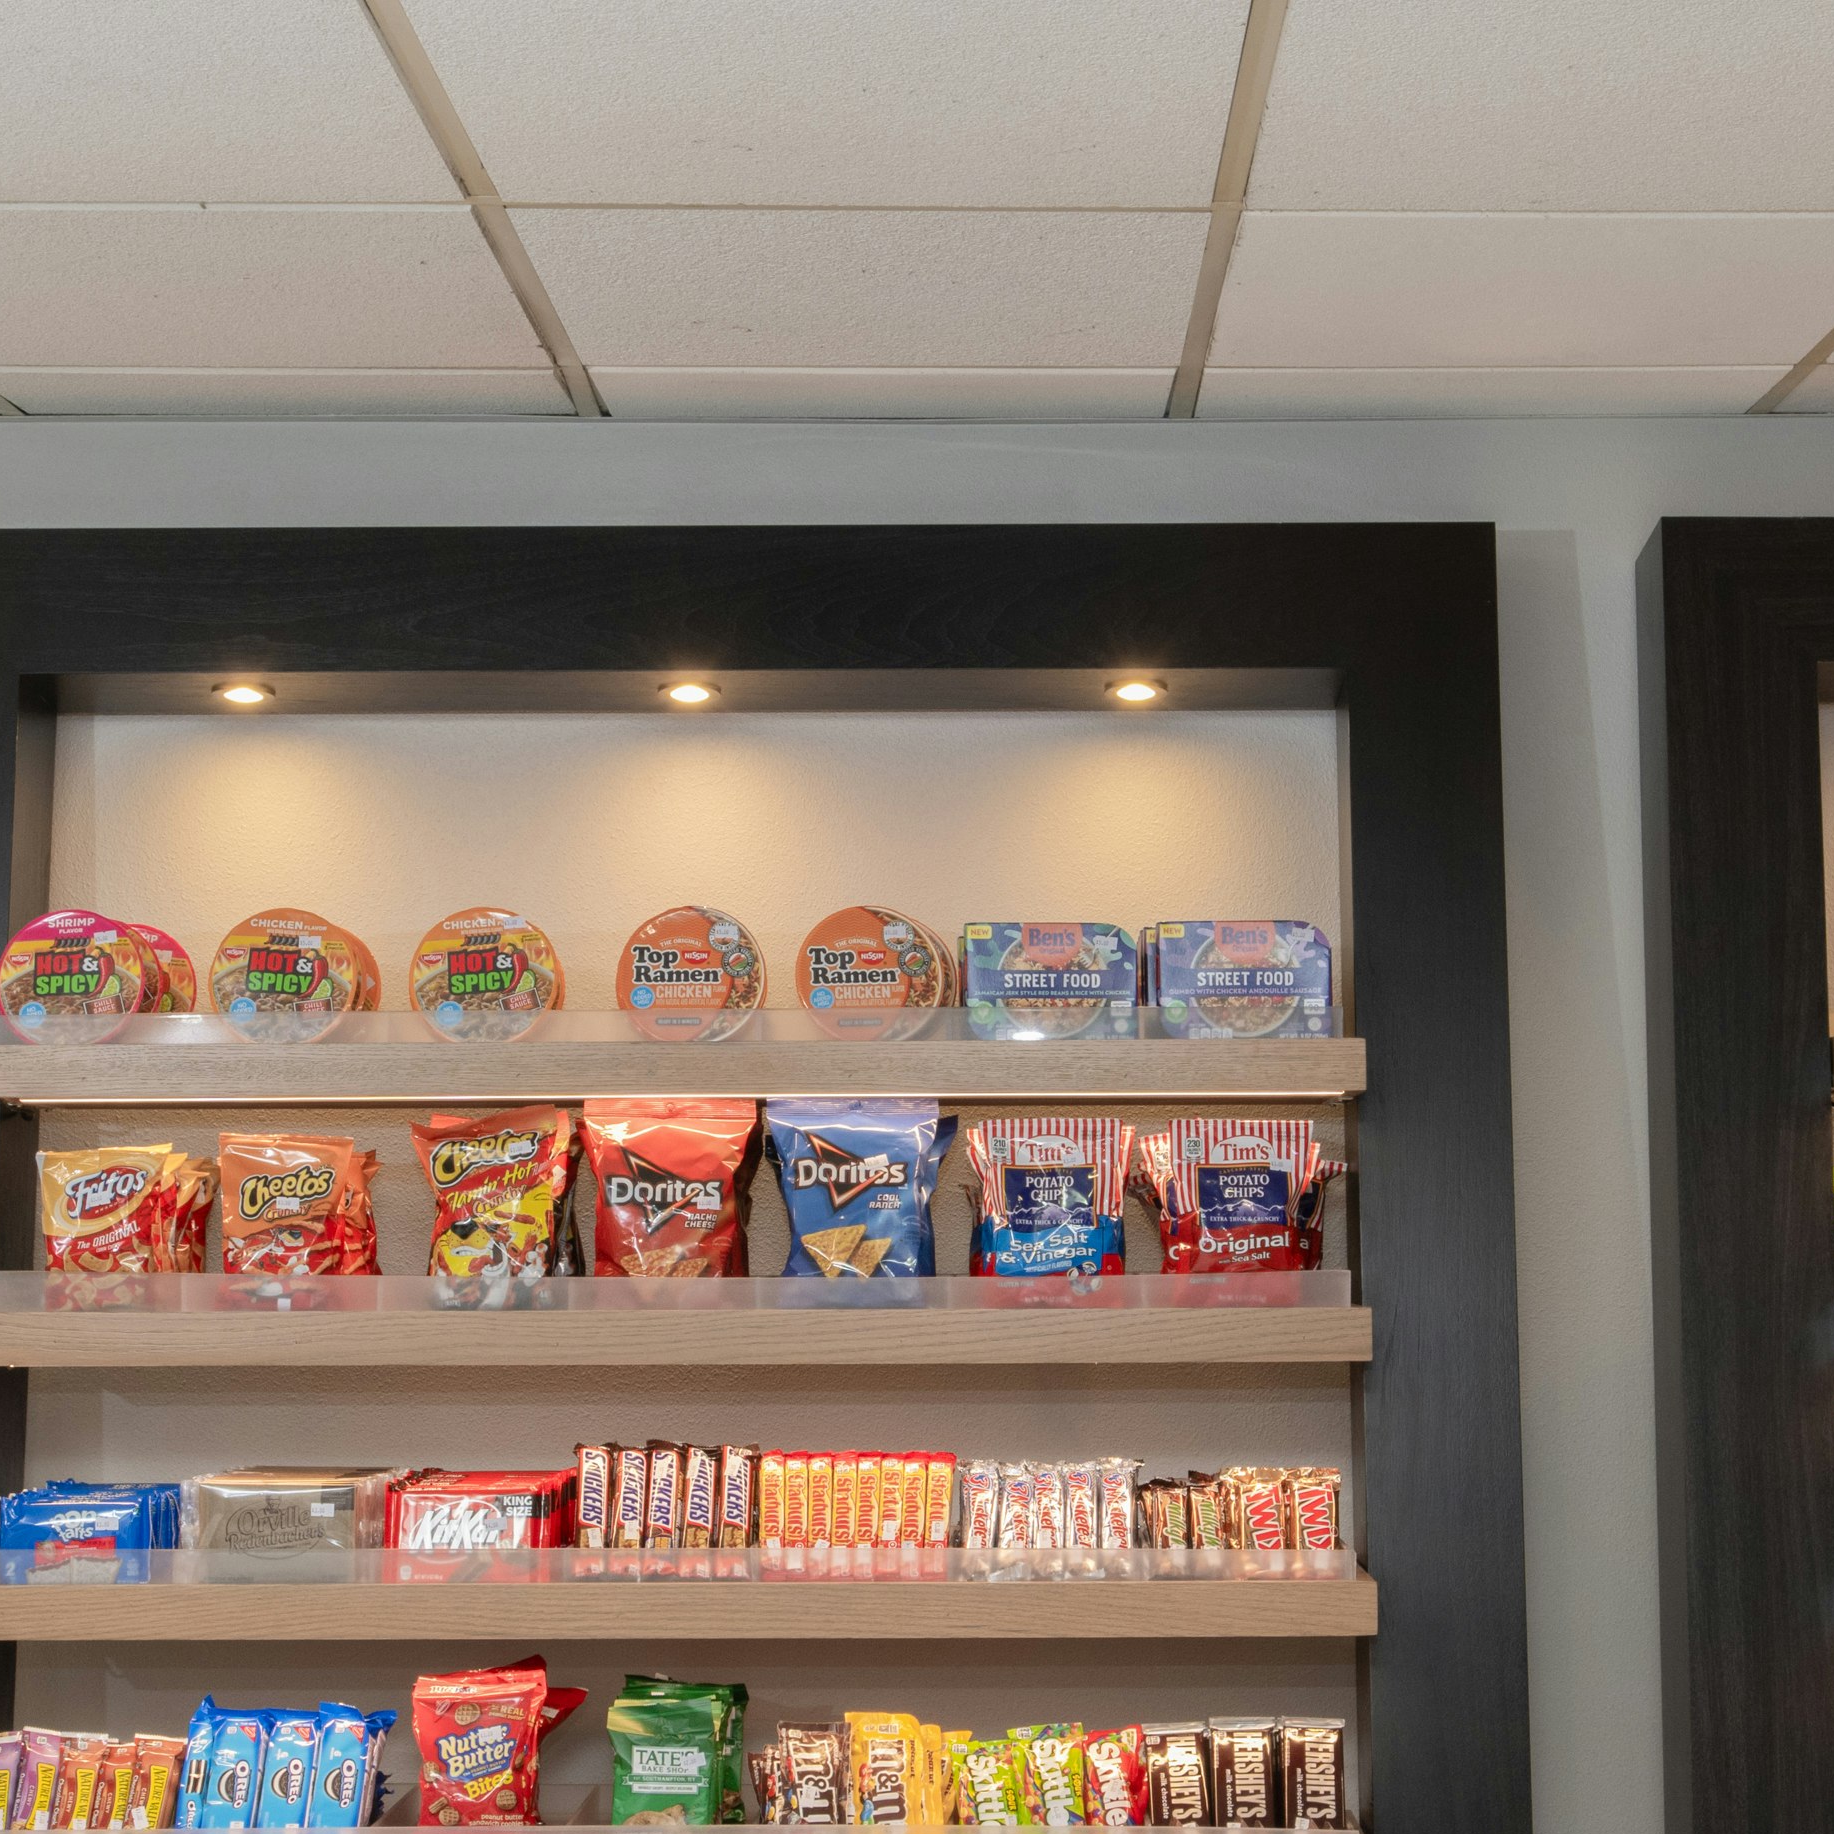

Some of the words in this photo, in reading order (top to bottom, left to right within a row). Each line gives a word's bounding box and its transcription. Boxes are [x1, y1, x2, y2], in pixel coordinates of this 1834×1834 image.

[48, 917, 95, 928] SHRIMP
[250, 918, 304, 930] CHICKEN
[442, 918, 496, 930] CHICKEN
[1029, 928, 1075, 946] Ben's
[1222, 927, 1268, 944] Ben's
[633, 945, 678, 966] Top
[808, 947, 855, 969] Top
[248, 971, 311, 993] SPICY
[451, 972, 513, 994] SPICY
[633, 966, 720, 983] Ramen
[809, 966, 896, 986] Ramen
[1004, 973, 1056, 987] STREET
[1063, 973, 1100, 987] FOOD
[1197, 972, 1249, 986] STREET
[1257, 972, 1293, 985] FOOD
[35, 975, 98, 995] SPICY
[656, 985, 712, 998] CHICKEN
[835, 986, 891, 1000] CHICKEN
[1187, 1139, 1201, 1149] 230
[1220, 1142, 1269, 1162] Tim's
[797, 1159, 906, 1188] Doritos
[1025, 1175, 1074, 1188] POTATO
[1219, 1175, 1270, 1187] POTATO
[239, 1166, 335, 1219] Cheetos
[610, 1177, 721, 1204] Doritos
[876, 1193, 899, 1202] COOL
[1031, 1188, 1067, 1201] CHIPS
[1224, 1186, 1265, 1198] CHIPS
[869, 1201, 901, 1209] RANCH
[684, 1220, 716, 1229] CHEESE
[92, 1221, 141, 1246] ORIGINAL
[1049, 1232, 1088, 1247] Salt
[1199, 1232, 1290, 1255] Original
[1022, 1246, 1096, 1261] Vinegar
[1249, 1251, 1270, 1262] Salt
[620, 1450, 647, 1525] SNICKERS
[503, 1495, 533, 1507] KING
[505, 1506, 533, 1517] SIZE
[238, 1508, 310, 1537] Orville
[501, 1706, 525, 1716] REAL
[446, 1740, 514, 1778] Butter
[636, 1748, 694, 1768] TATE'S
[641, 1765, 664, 1774] BAKE
[1233, 1732, 1267, 1818] HERSHEY'S
[1305, 1728, 1336, 1820] HERSHEY'S
[232, 1759, 251, 1808] OREO
[287, 1758, 303, 1805] OREO
[339, 1759, 356, 1808] OREO
[465, 1771, 513, 1798] Bites
